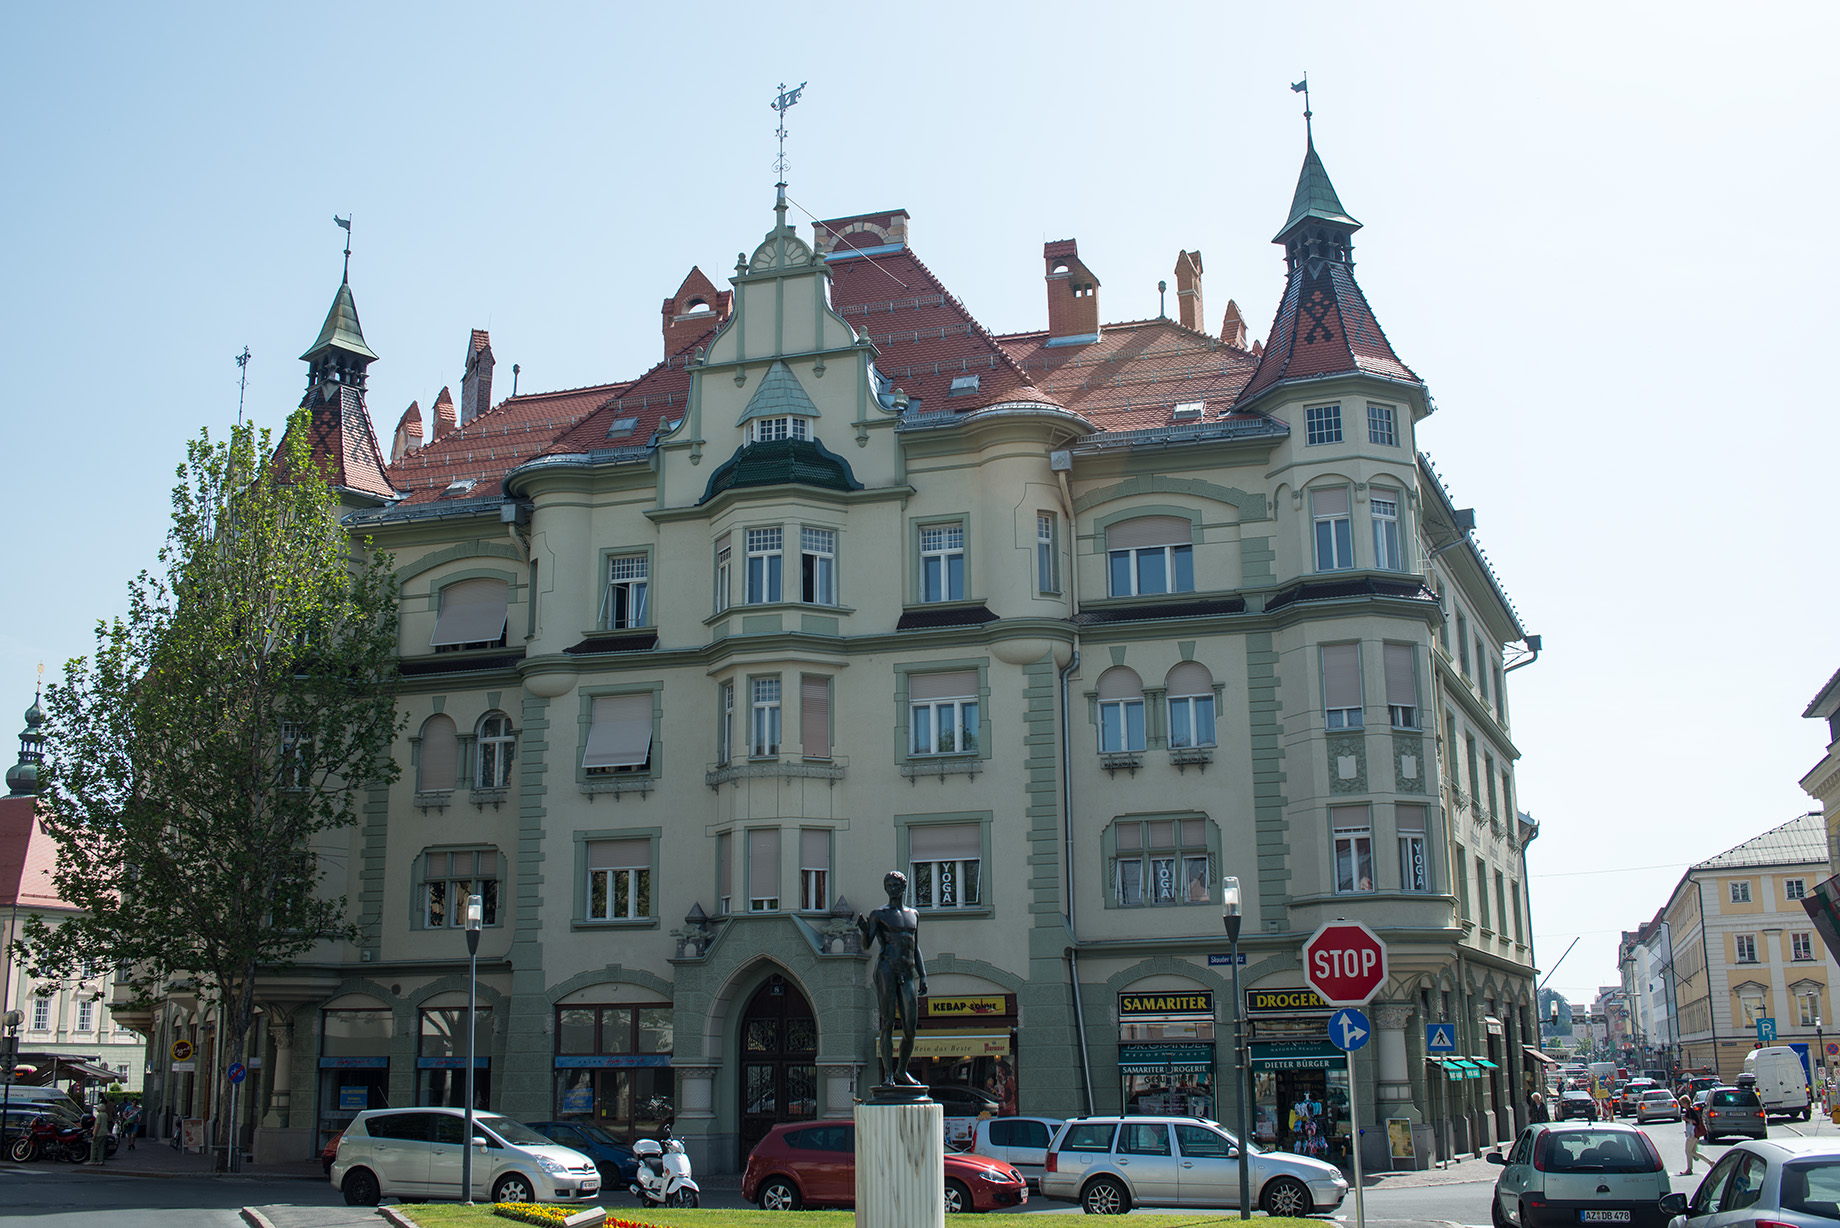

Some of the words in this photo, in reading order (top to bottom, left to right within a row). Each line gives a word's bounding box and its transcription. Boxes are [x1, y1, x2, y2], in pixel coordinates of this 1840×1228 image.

[1414, 843, 1424, 886] YOGA
[942, 862, 952, 903] YOGA
[1160, 859, 1170, 898] YOGA
[1314, 948, 1376, 979] STOP
[933, 1002, 966, 1012] KEBAP
[1123, 996, 1208, 1011] SAMARITER
[1257, 993, 1328, 1008] DROGERI
[936, 1044, 947, 1052] das
[950, 1044, 972, 1052] Beste
[1122, 1065, 1165, 1074] SAMARITER
[1264, 1061, 1294, 1069] DIETER
[1296, 1059, 1330, 1068] BÜRGER
[1586, 1211, 1597, 1221] AZ
[1601, 1211, 1613, 1221] DB
[1614, 1211, 1630, 1221] 478
